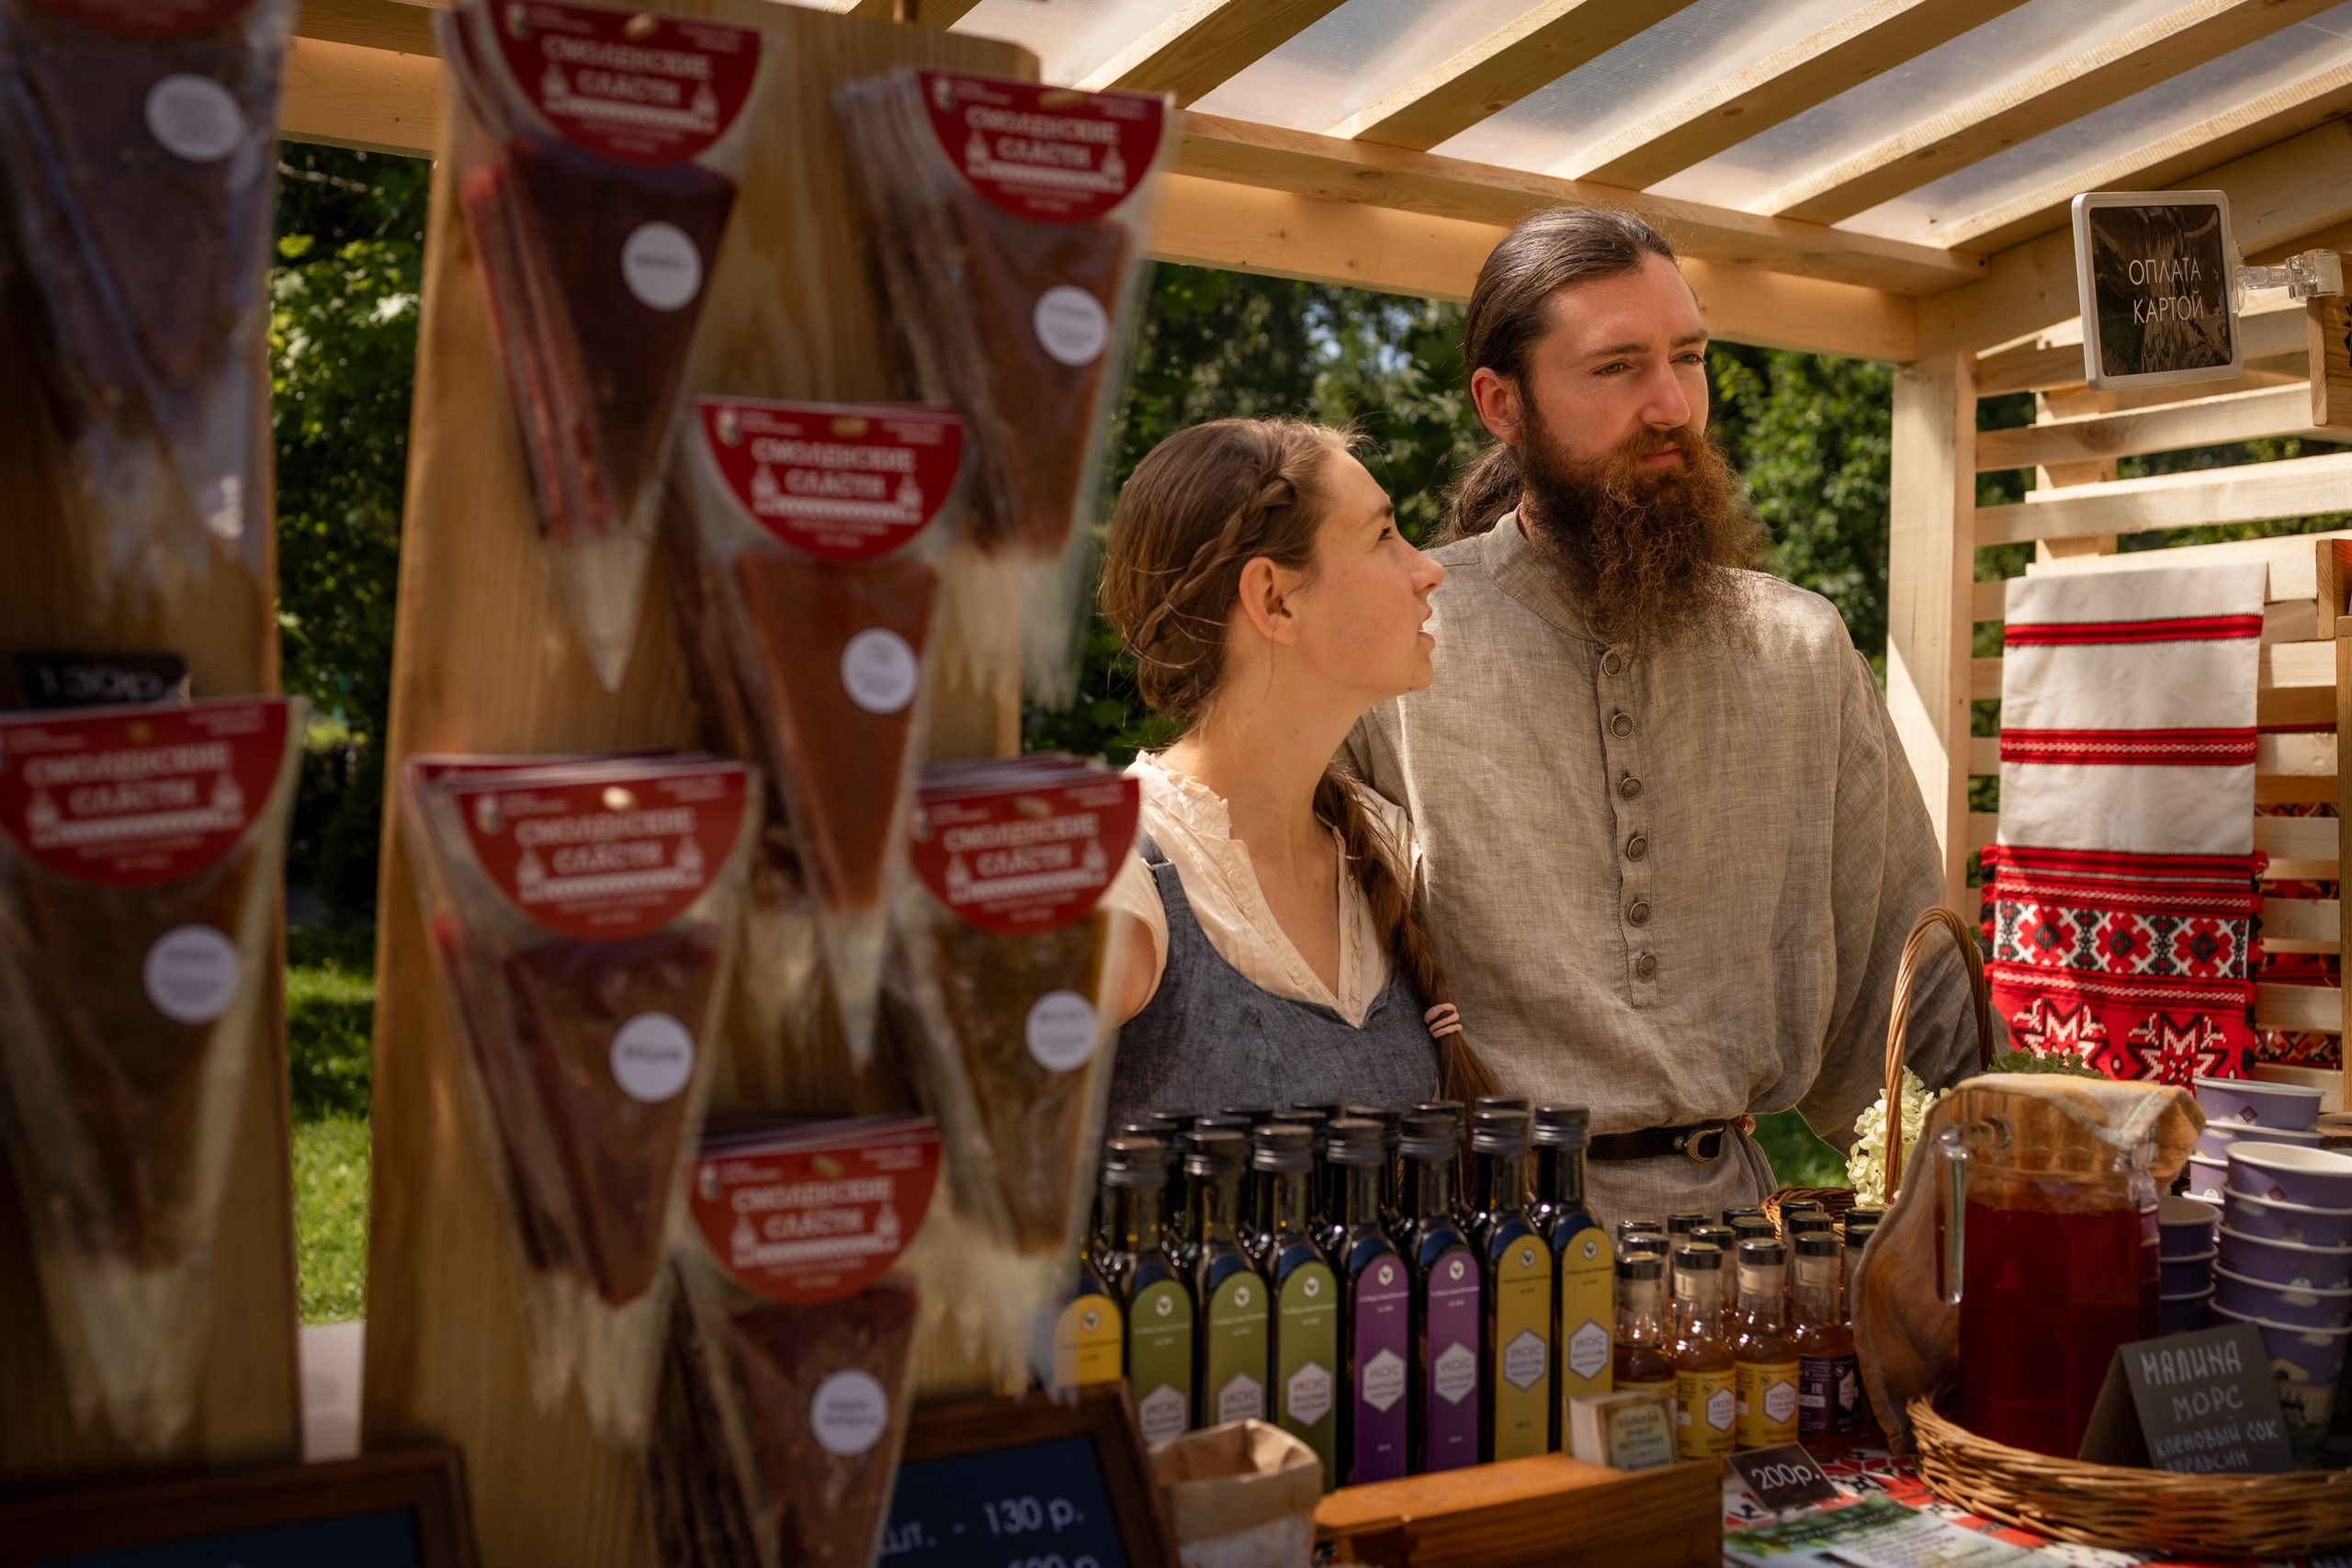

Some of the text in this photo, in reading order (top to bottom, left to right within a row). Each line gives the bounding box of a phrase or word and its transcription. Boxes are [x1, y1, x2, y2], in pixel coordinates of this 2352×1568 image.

[2128, 257, 2201, 286] ОПЛАТА
[2133, 289, 2204, 324] КАРТОЙ
[2140, 1340, 2242, 1386] МАЛИНА
[2172, 1385, 2244, 1423] МОРС
[984, 1495, 1043, 1536] 130
